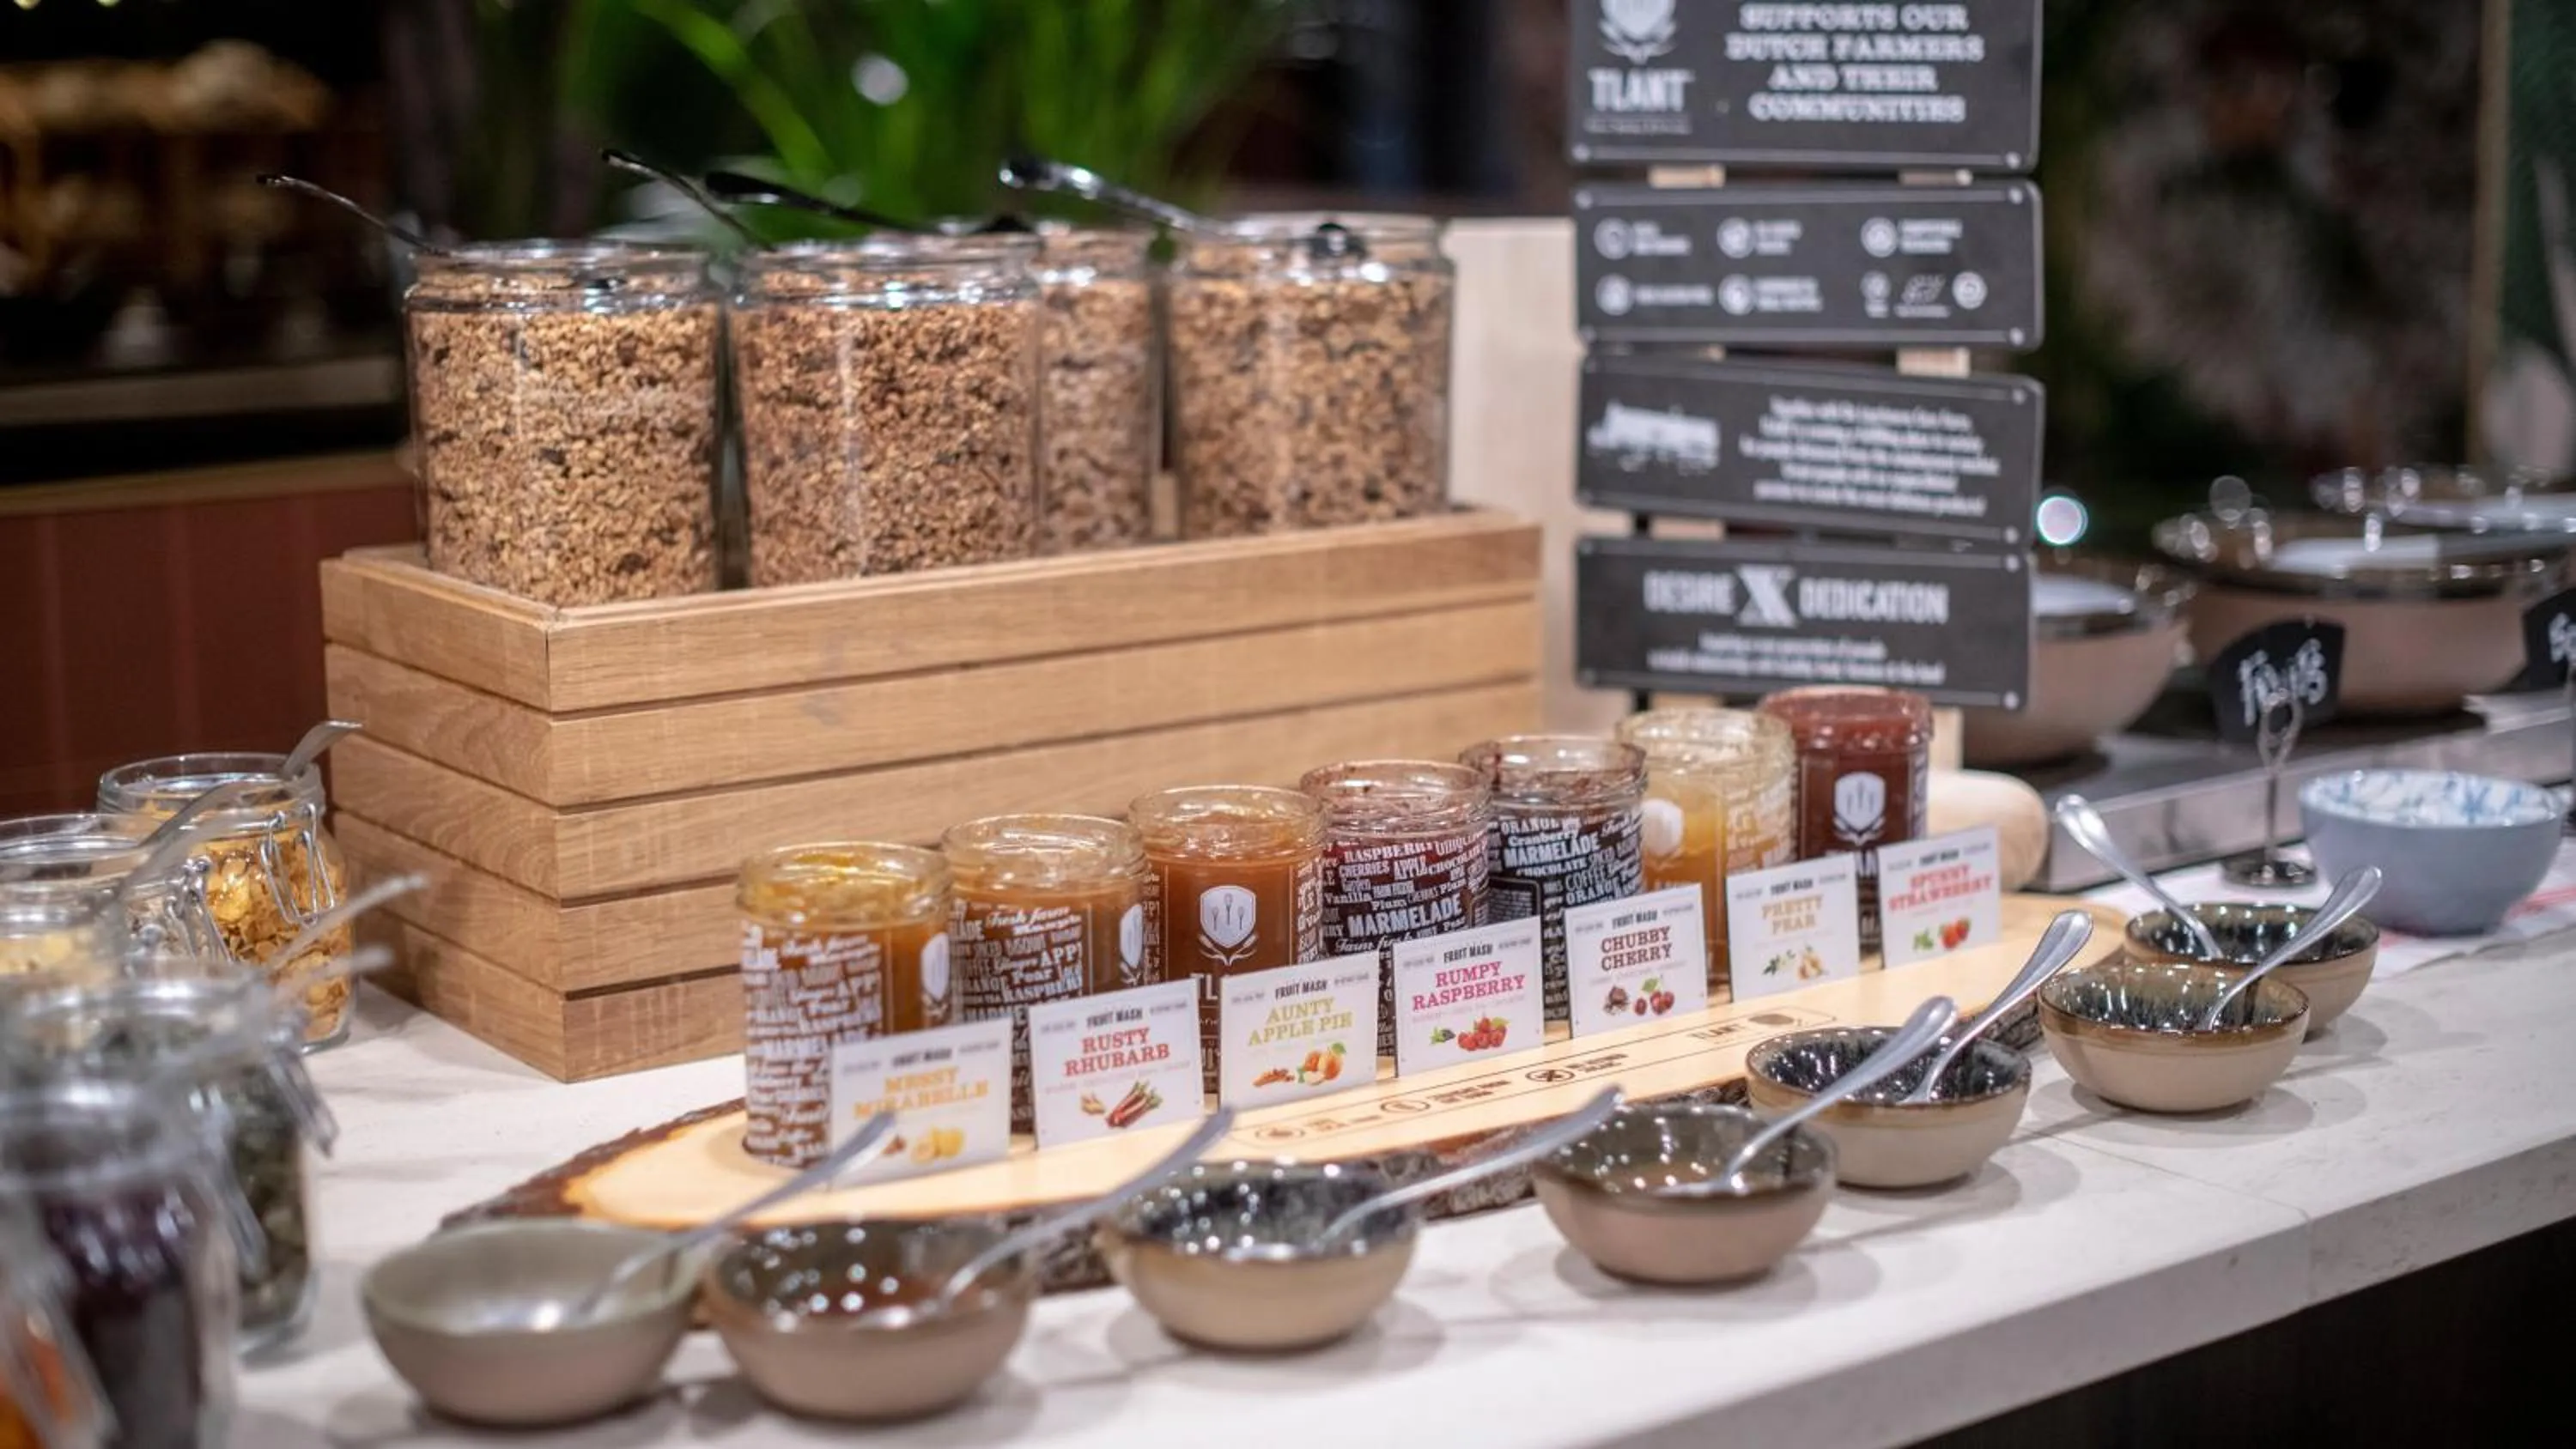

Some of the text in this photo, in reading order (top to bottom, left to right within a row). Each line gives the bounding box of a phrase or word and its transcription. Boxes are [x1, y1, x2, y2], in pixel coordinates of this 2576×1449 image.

[1740, 3, 1969, 31] SUPPORTS OUR
[1725, 33, 1985, 62] DUTCH FARMERS
[1768, 64, 1939, 92] AND THEIR
[1747, 92, 1966, 122] COMMUNITIES
[1643, 563, 1949, 627] DESIRE X DEDICATION
[1504, 832, 1600, 869] MARMELADE
[1347, 894, 1462, 938] MARMELADE
[1613, 910, 1658, 929] FRUIT MASH
[1762, 894, 1823, 920] PRETTY
[1601, 925, 1670, 953] CHUBBY
[1773, 914, 1815, 936] PEAR
[1443, 943, 1492, 963] FRUIT MASH
[1601, 943, 1673, 972] CHERRY
[1436, 961, 1502, 987] RUMPY
[1275, 983, 1300, 1000] FRUIT
[1302, 979, 1327, 993] MASH
[1413, 974, 1526, 1010] RASPBERRY
[1087, 1011, 1113, 1028] FRUIT
[1116, 1008, 1143, 1022] MASH
[1265, 997, 1335, 1025] AUNTY
[1082, 1028, 1150, 1053] RUSTY
[1249, 1011, 1353, 1046] APPLE PIE
[1065, 1044, 1170, 1076] RHUBARB
